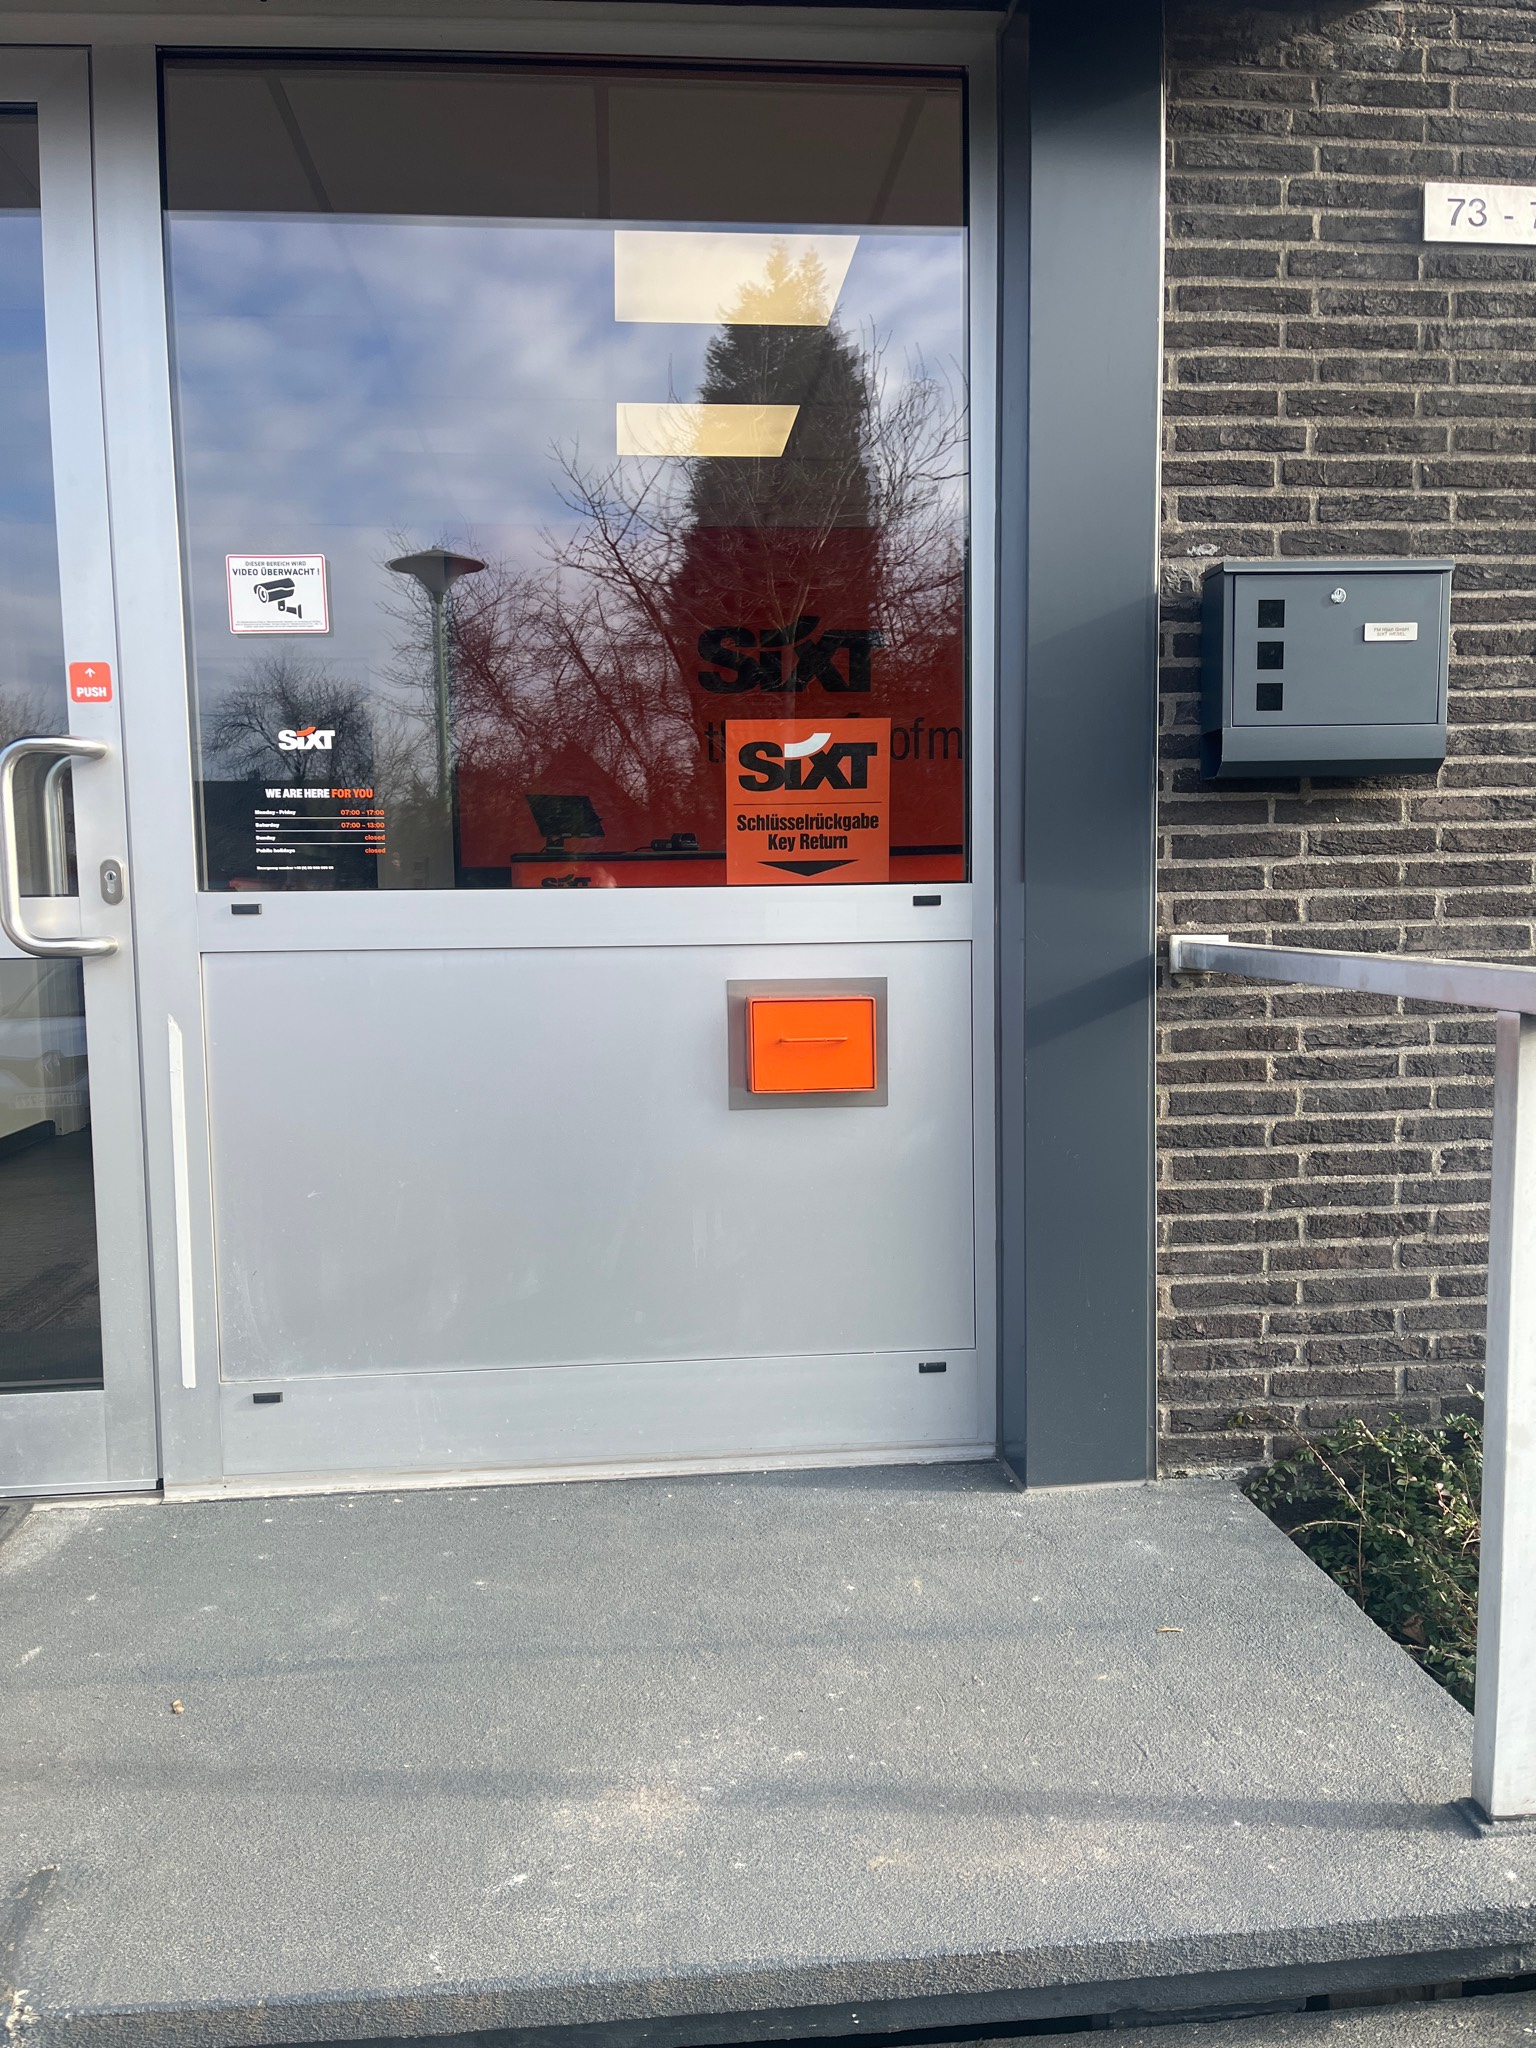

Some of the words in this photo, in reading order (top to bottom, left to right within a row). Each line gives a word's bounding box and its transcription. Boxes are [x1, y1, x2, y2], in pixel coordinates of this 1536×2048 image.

[1447, 198, 1488, 227] 73
[232, 568, 259, 576] VIDEO
[260, 566, 315, 576] ÜBERWACHT
[76, 686, 107, 698] PUSH
[265, 788, 282, 799] WE
[282, 788, 303, 799] ARE
[304, 788, 330, 799] HERE
[331, 788, 351, 799] FOR
[353, 788, 373, 799] YOU
[736, 812, 879, 832] Schlüsselrückgabe
[767, 834, 796, 853] Key
[799, 833, 848, 850] Return
